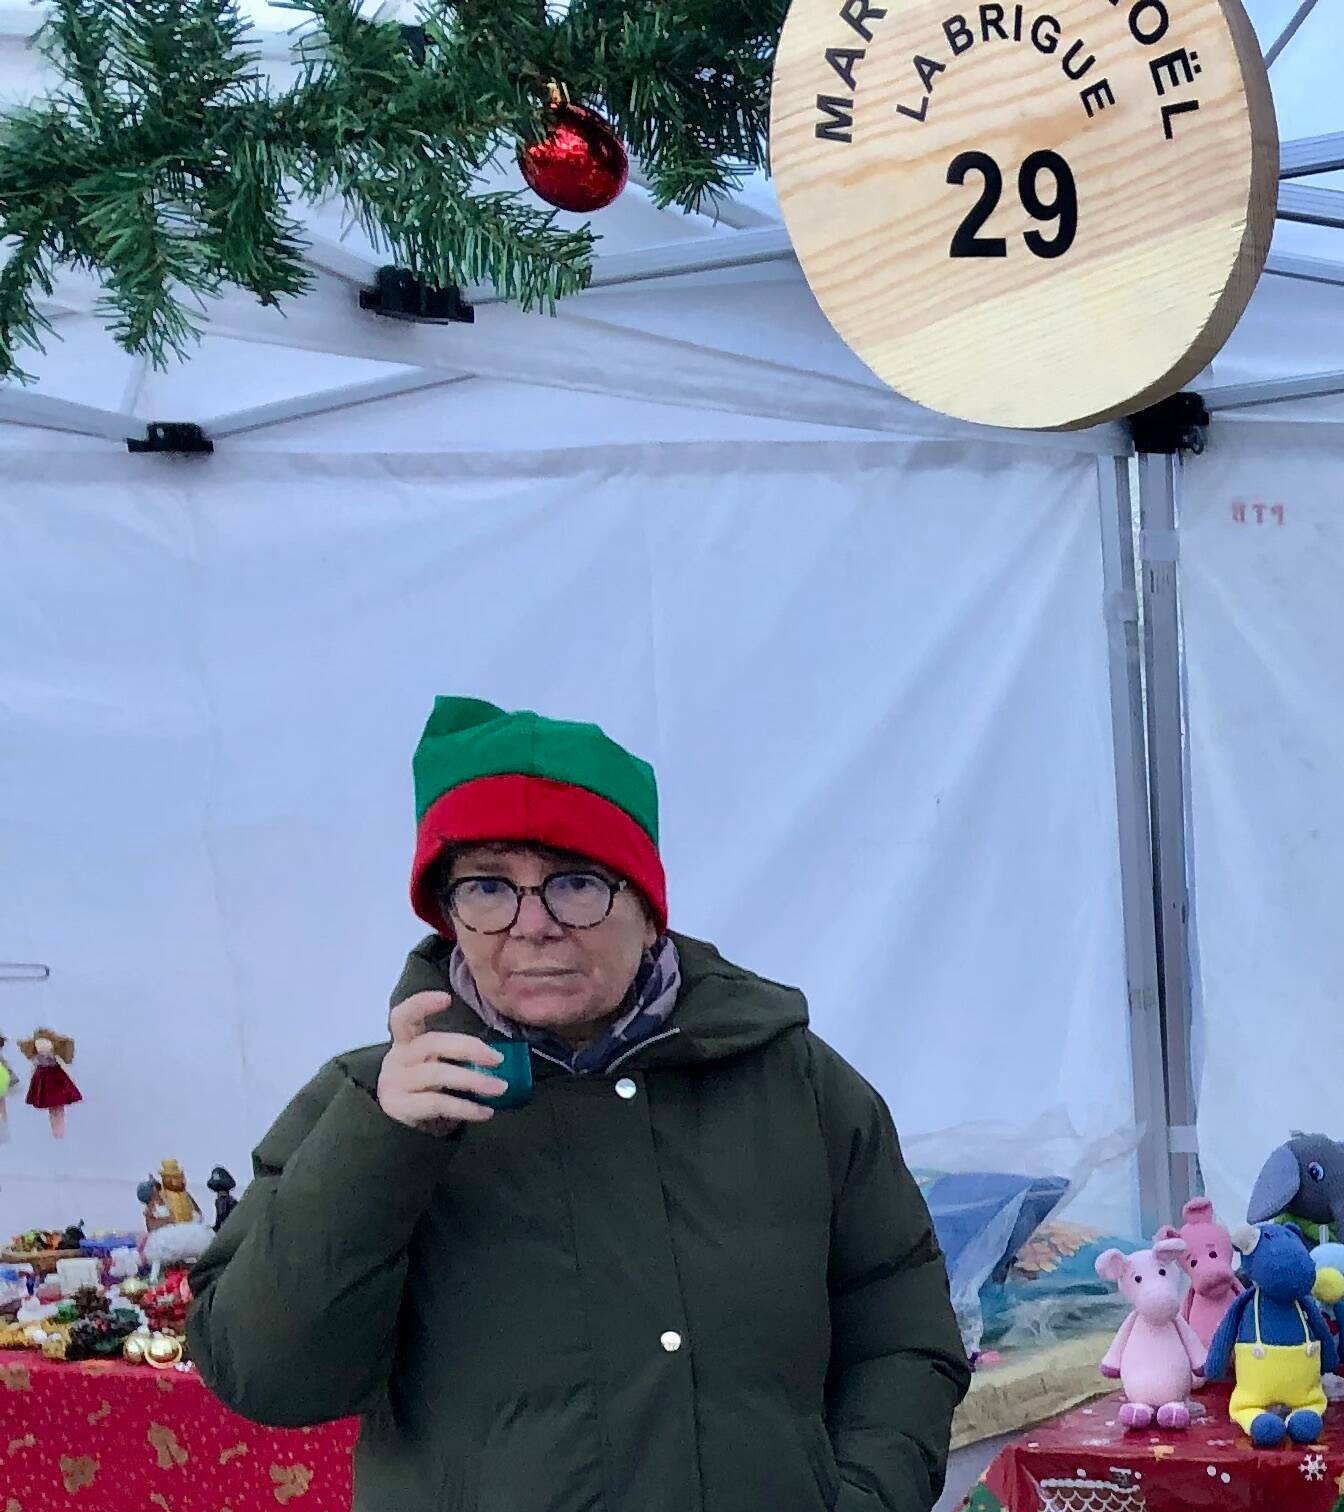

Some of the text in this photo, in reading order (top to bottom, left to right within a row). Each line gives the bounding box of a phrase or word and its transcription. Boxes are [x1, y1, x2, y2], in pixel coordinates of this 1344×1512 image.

[896, 3, 1116, 122] LA BRIGUE
[1107, 0, 1202, 139] OËL
[946, 149, 1079, 258] 29
